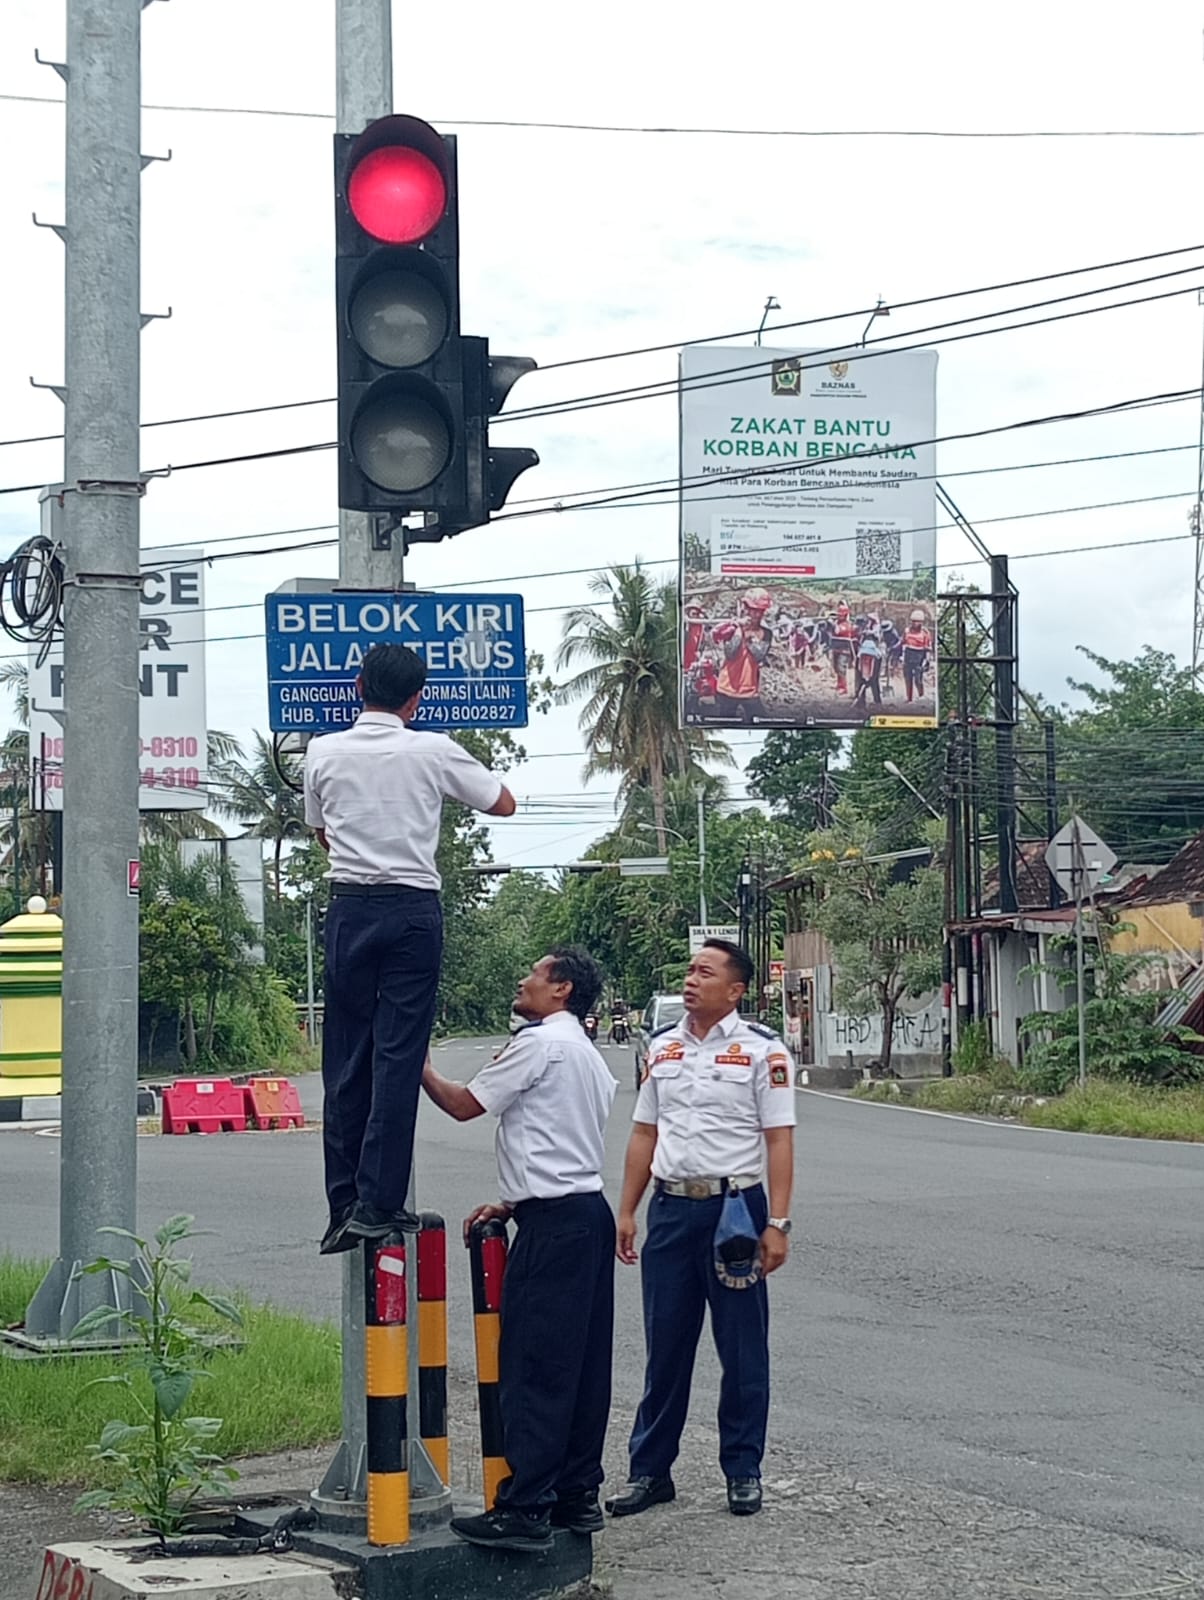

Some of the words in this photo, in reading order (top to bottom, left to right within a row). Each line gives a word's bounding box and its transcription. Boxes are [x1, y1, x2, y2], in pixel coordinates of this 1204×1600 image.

[730, 417, 806, 435] ZAKAT
[814, 419, 891, 436] BANTU
[703, 439, 797, 457] KORBAN
[277, 603, 421, 633] BELOK
[436, 603, 513, 632] KIRI
[281, 642, 390, 673] JALA
[280, 687, 356, 702] GANGGUAN
[422, 684, 471, 700] ORMASI
[281, 707, 320, 723] HUB.
